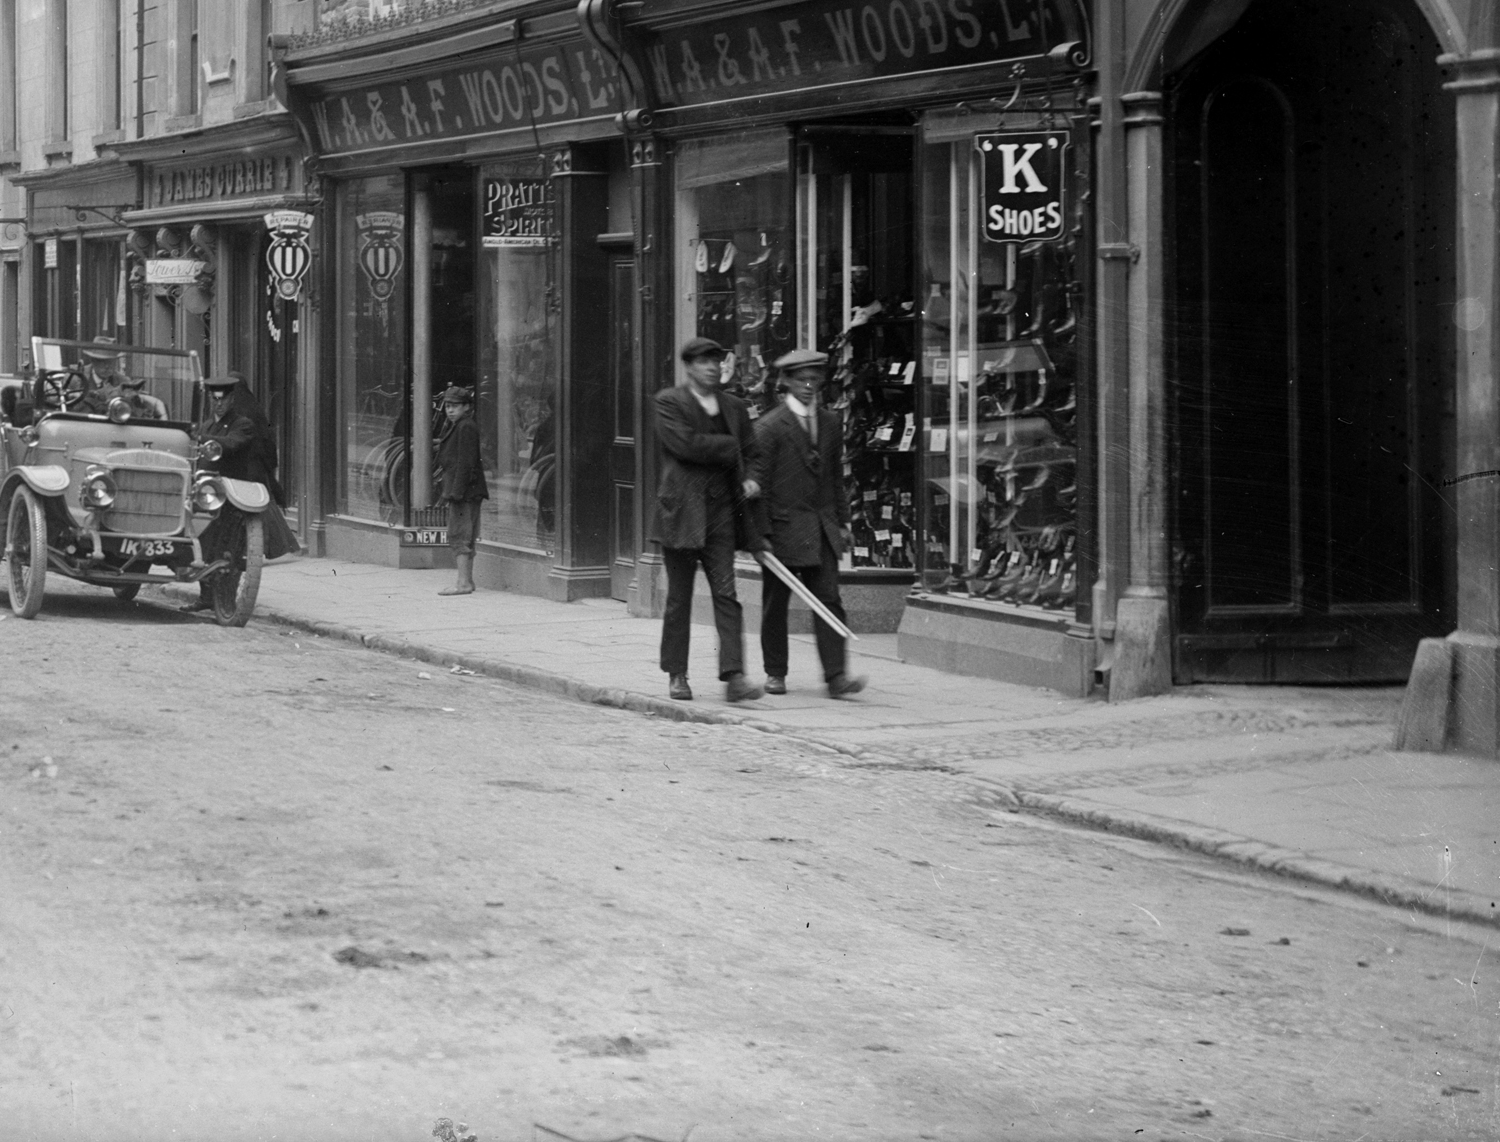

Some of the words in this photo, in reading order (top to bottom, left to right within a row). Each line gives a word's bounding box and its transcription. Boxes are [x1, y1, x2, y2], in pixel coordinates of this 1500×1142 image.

[165, 165, 212, 201] JAMES
[217, 156, 273, 196] CURRIE
[269, 216, 309, 225] REPAIRER
[987, 201, 1061, 235] SHOES
[417, 532, 437, 543] NEW
[120, 538, 139, 556] IK
[144, 540, 174, 557] 833
